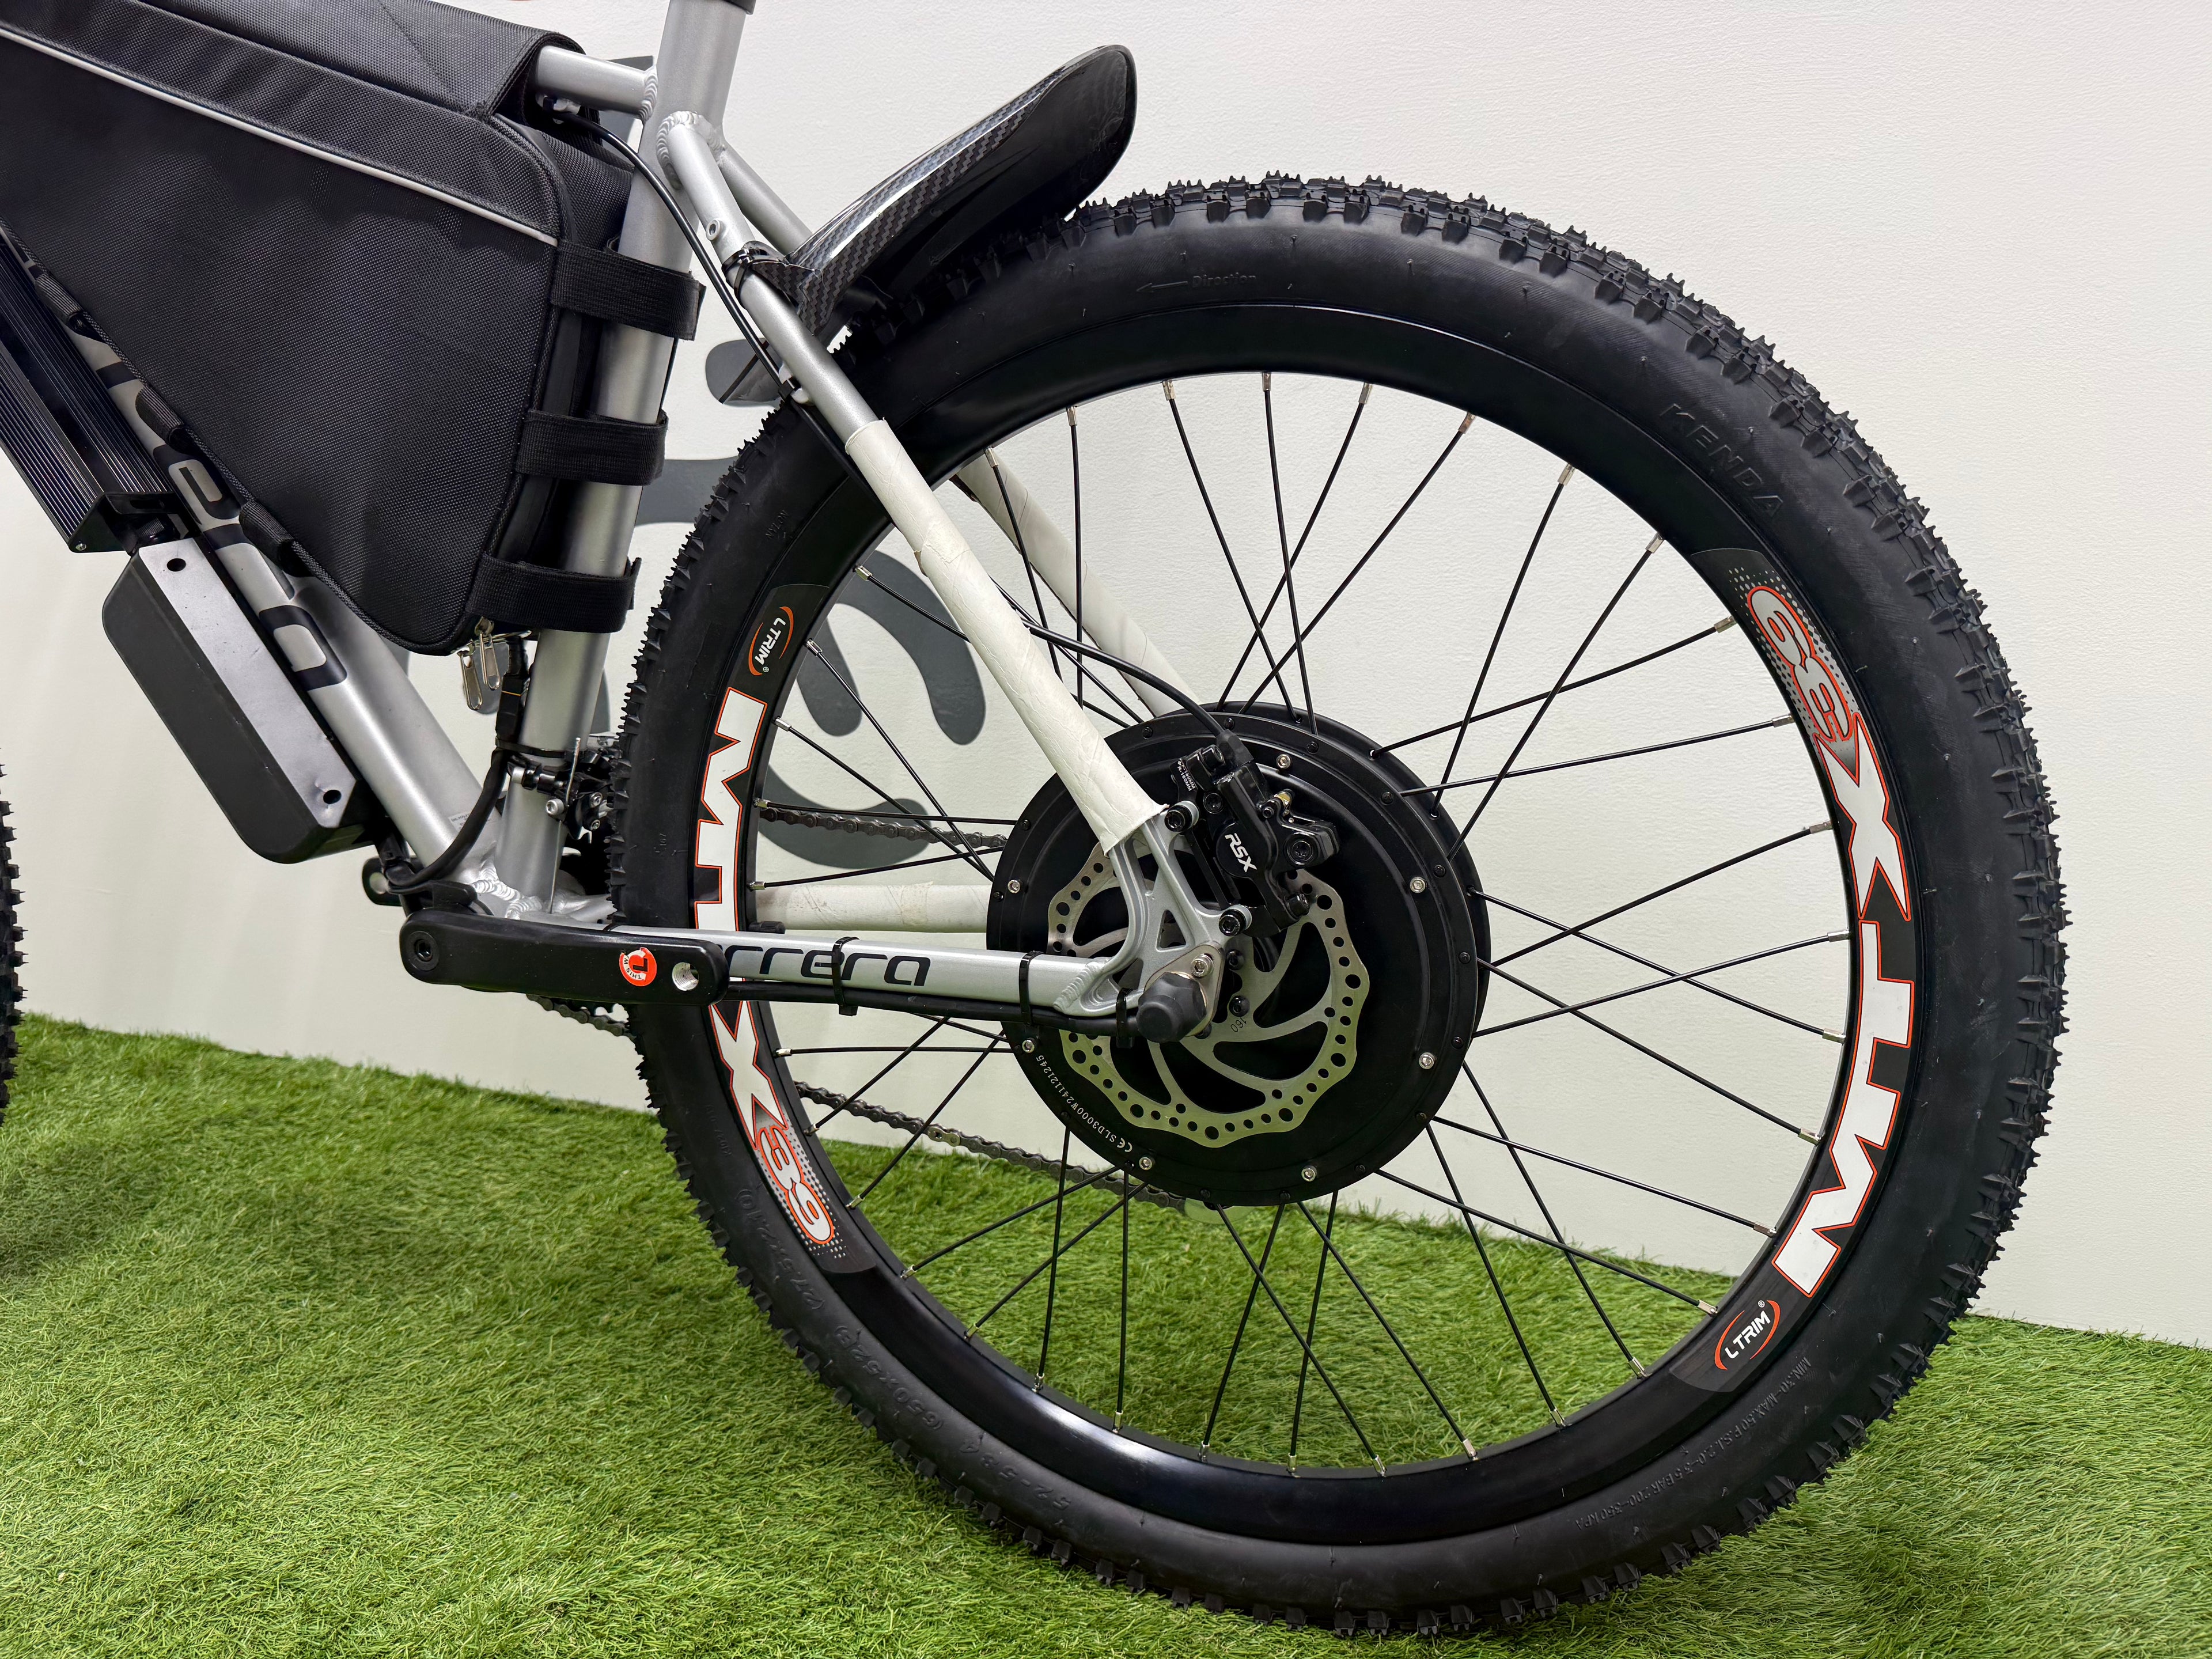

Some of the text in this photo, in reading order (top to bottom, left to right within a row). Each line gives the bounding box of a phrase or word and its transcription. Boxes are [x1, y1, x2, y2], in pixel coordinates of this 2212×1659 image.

[1660, 403, 1784, 517] KENDA
[1225, 833, 1257, 873] RSX
[626, 968, 642, 979] THIS
[717, 944, 931, 987] rrera
[1230, 1017, 1247, 1032] 160
[1036, 1055, 1117, 1142] SLD3000W241121245
[959, 1439, 1071, 1510] 52-584
